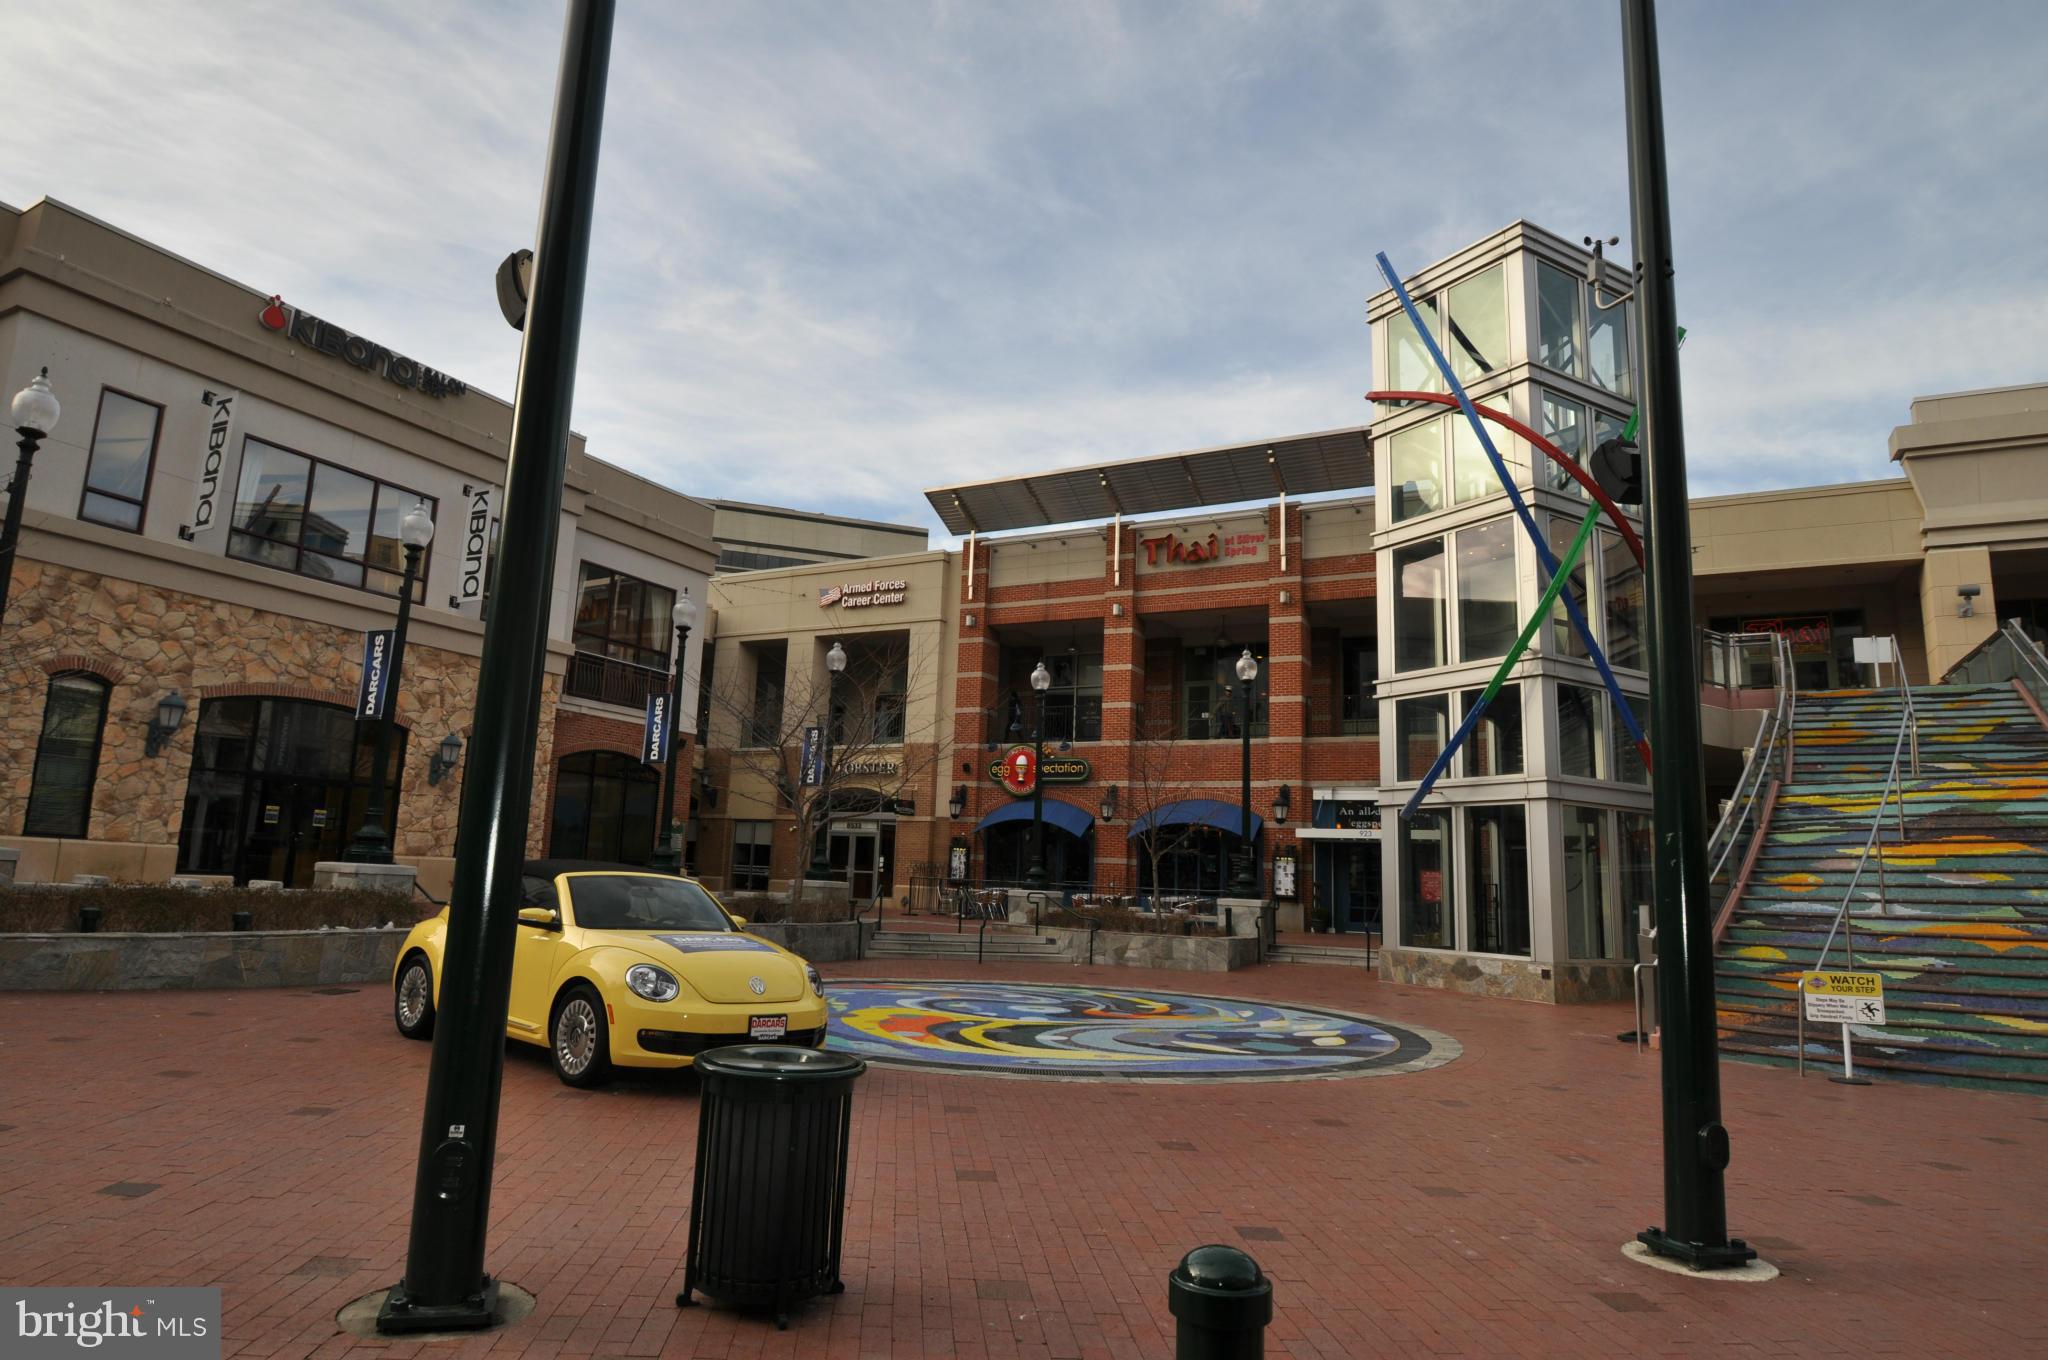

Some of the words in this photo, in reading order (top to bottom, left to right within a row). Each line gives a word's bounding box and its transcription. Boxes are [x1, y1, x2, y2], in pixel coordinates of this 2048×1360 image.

[1140, 533, 1219, 566] Thai
[843, 581, 872, 594] Armed
[874, 580, 906, 591] Forces
[842, 596, 872, 607] Career
[873, 592, 904, 604] Center
[365, 634, 385, 715] DARCARS
[650, 696, 664, 760] DARCARS
[1339, 807, 1354, 816] An
[1830, 975, 1875, 986] WATCH
[1831, 985, 1854, 993] YOUR
[1855, 986, 1875, 994] STEP
[752, 1017, 785, 1028] DARCARS
